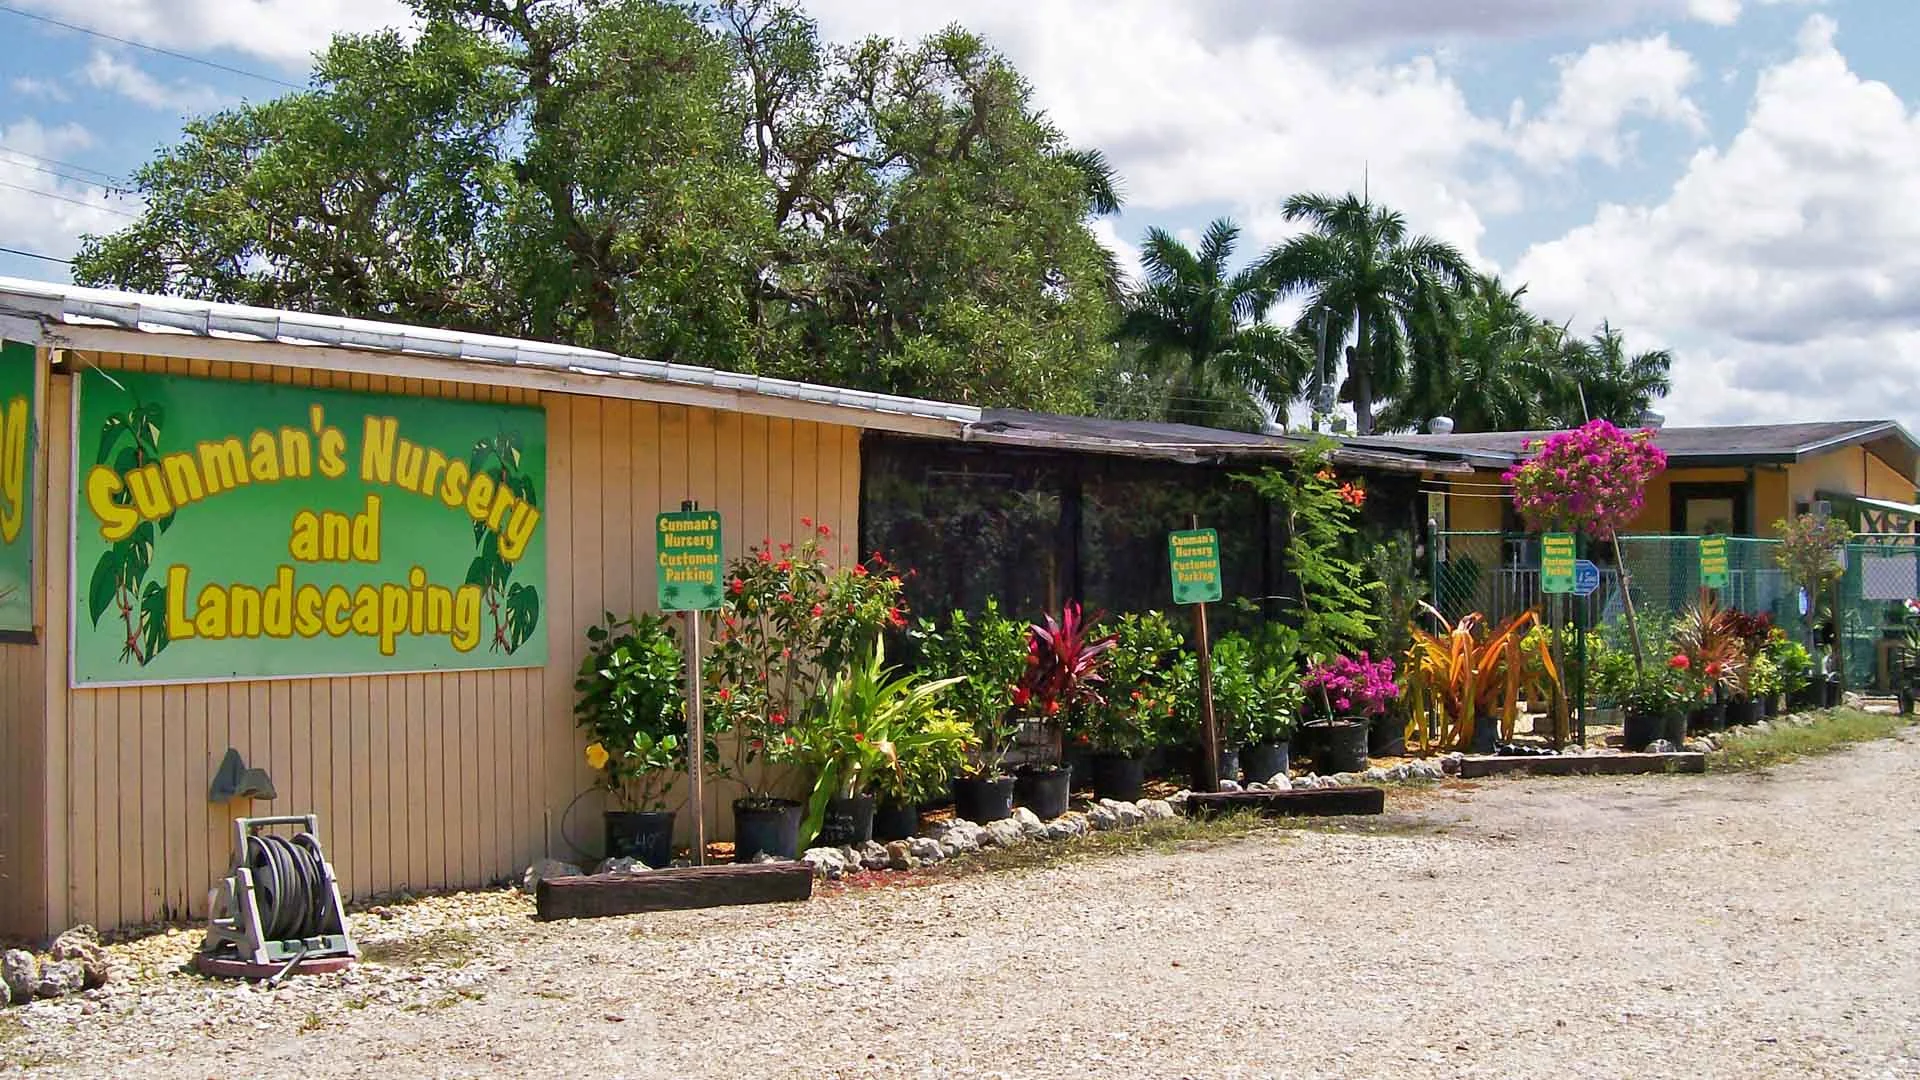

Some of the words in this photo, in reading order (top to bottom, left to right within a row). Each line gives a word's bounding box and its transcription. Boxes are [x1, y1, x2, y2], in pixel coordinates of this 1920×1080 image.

[87, 404, 346, 540] Sunman's
[360, 415, 541, 561] Nursery
[289, 495, 380, 562] and
[660, 515, 718, 531] Sunman's
[665, 533, 713, 549] Nursery
[659, 552, 718, 566] Customer
[666, 567, 713, 583] Parking
[166, 565, 483, 656] Landscaping
